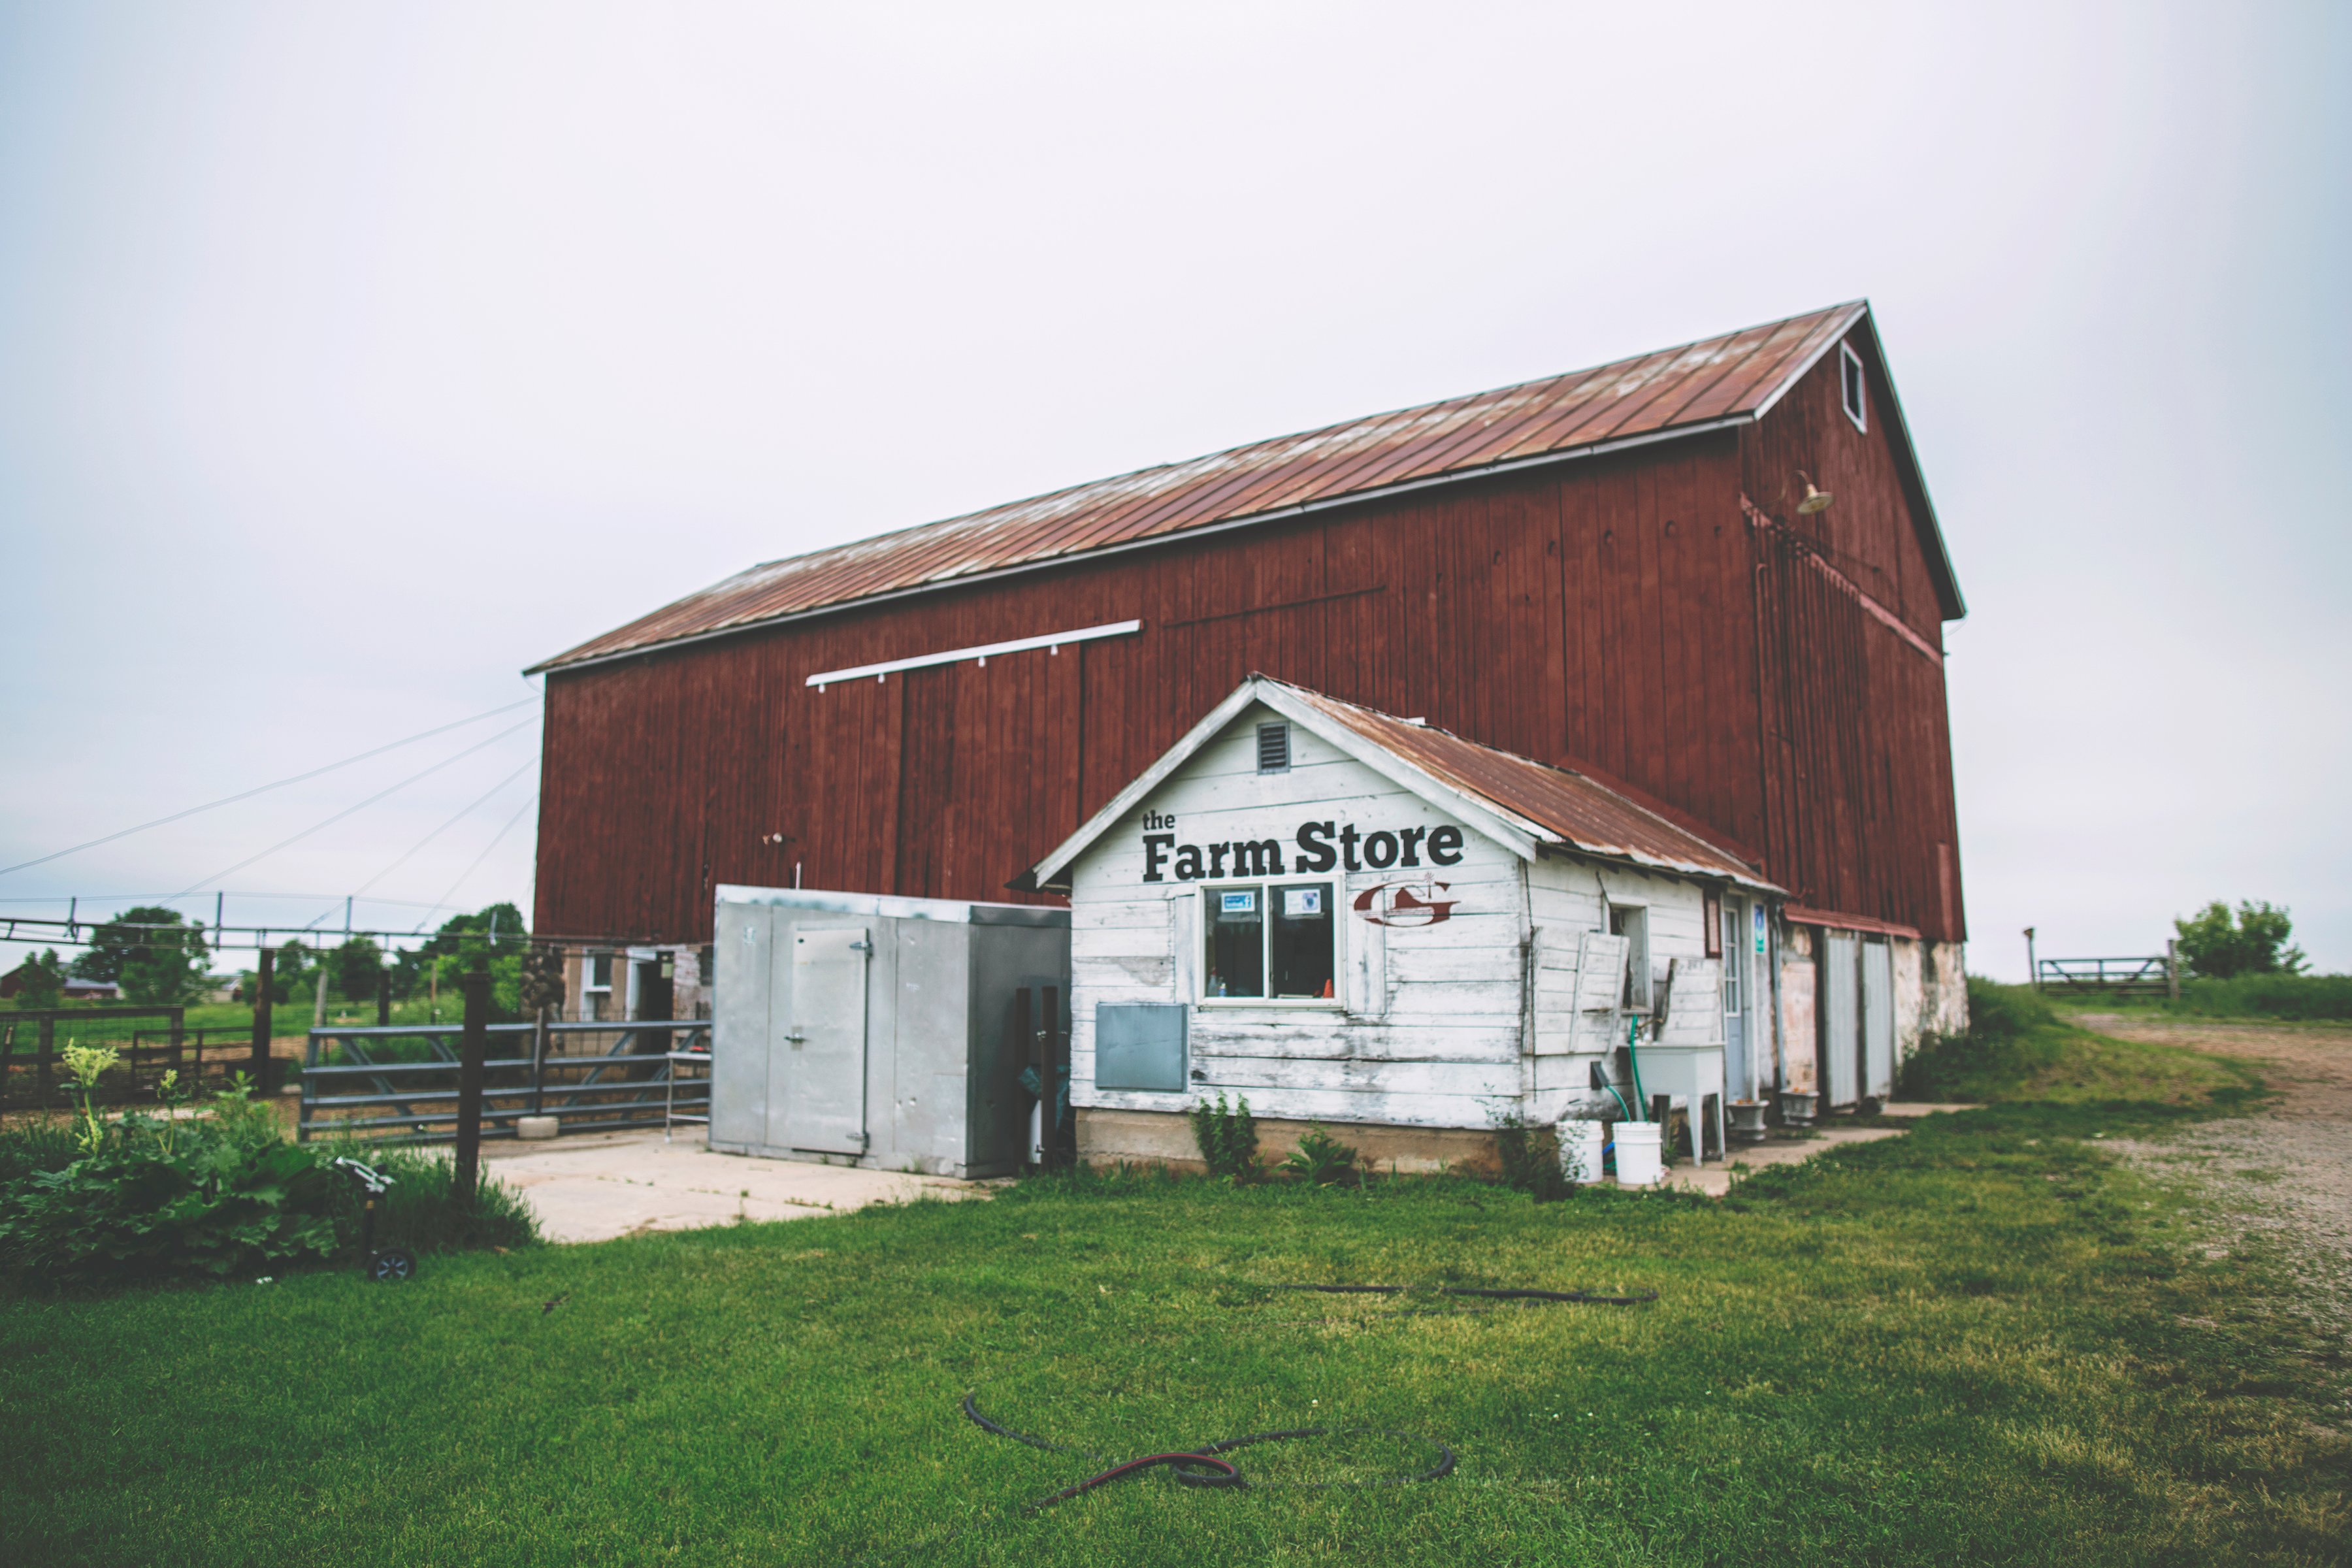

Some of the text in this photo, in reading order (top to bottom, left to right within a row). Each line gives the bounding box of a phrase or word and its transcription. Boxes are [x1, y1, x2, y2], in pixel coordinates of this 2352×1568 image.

[1143, 809, 1175, 830] the
[1143, 821, 1463, 881] Farm Store
